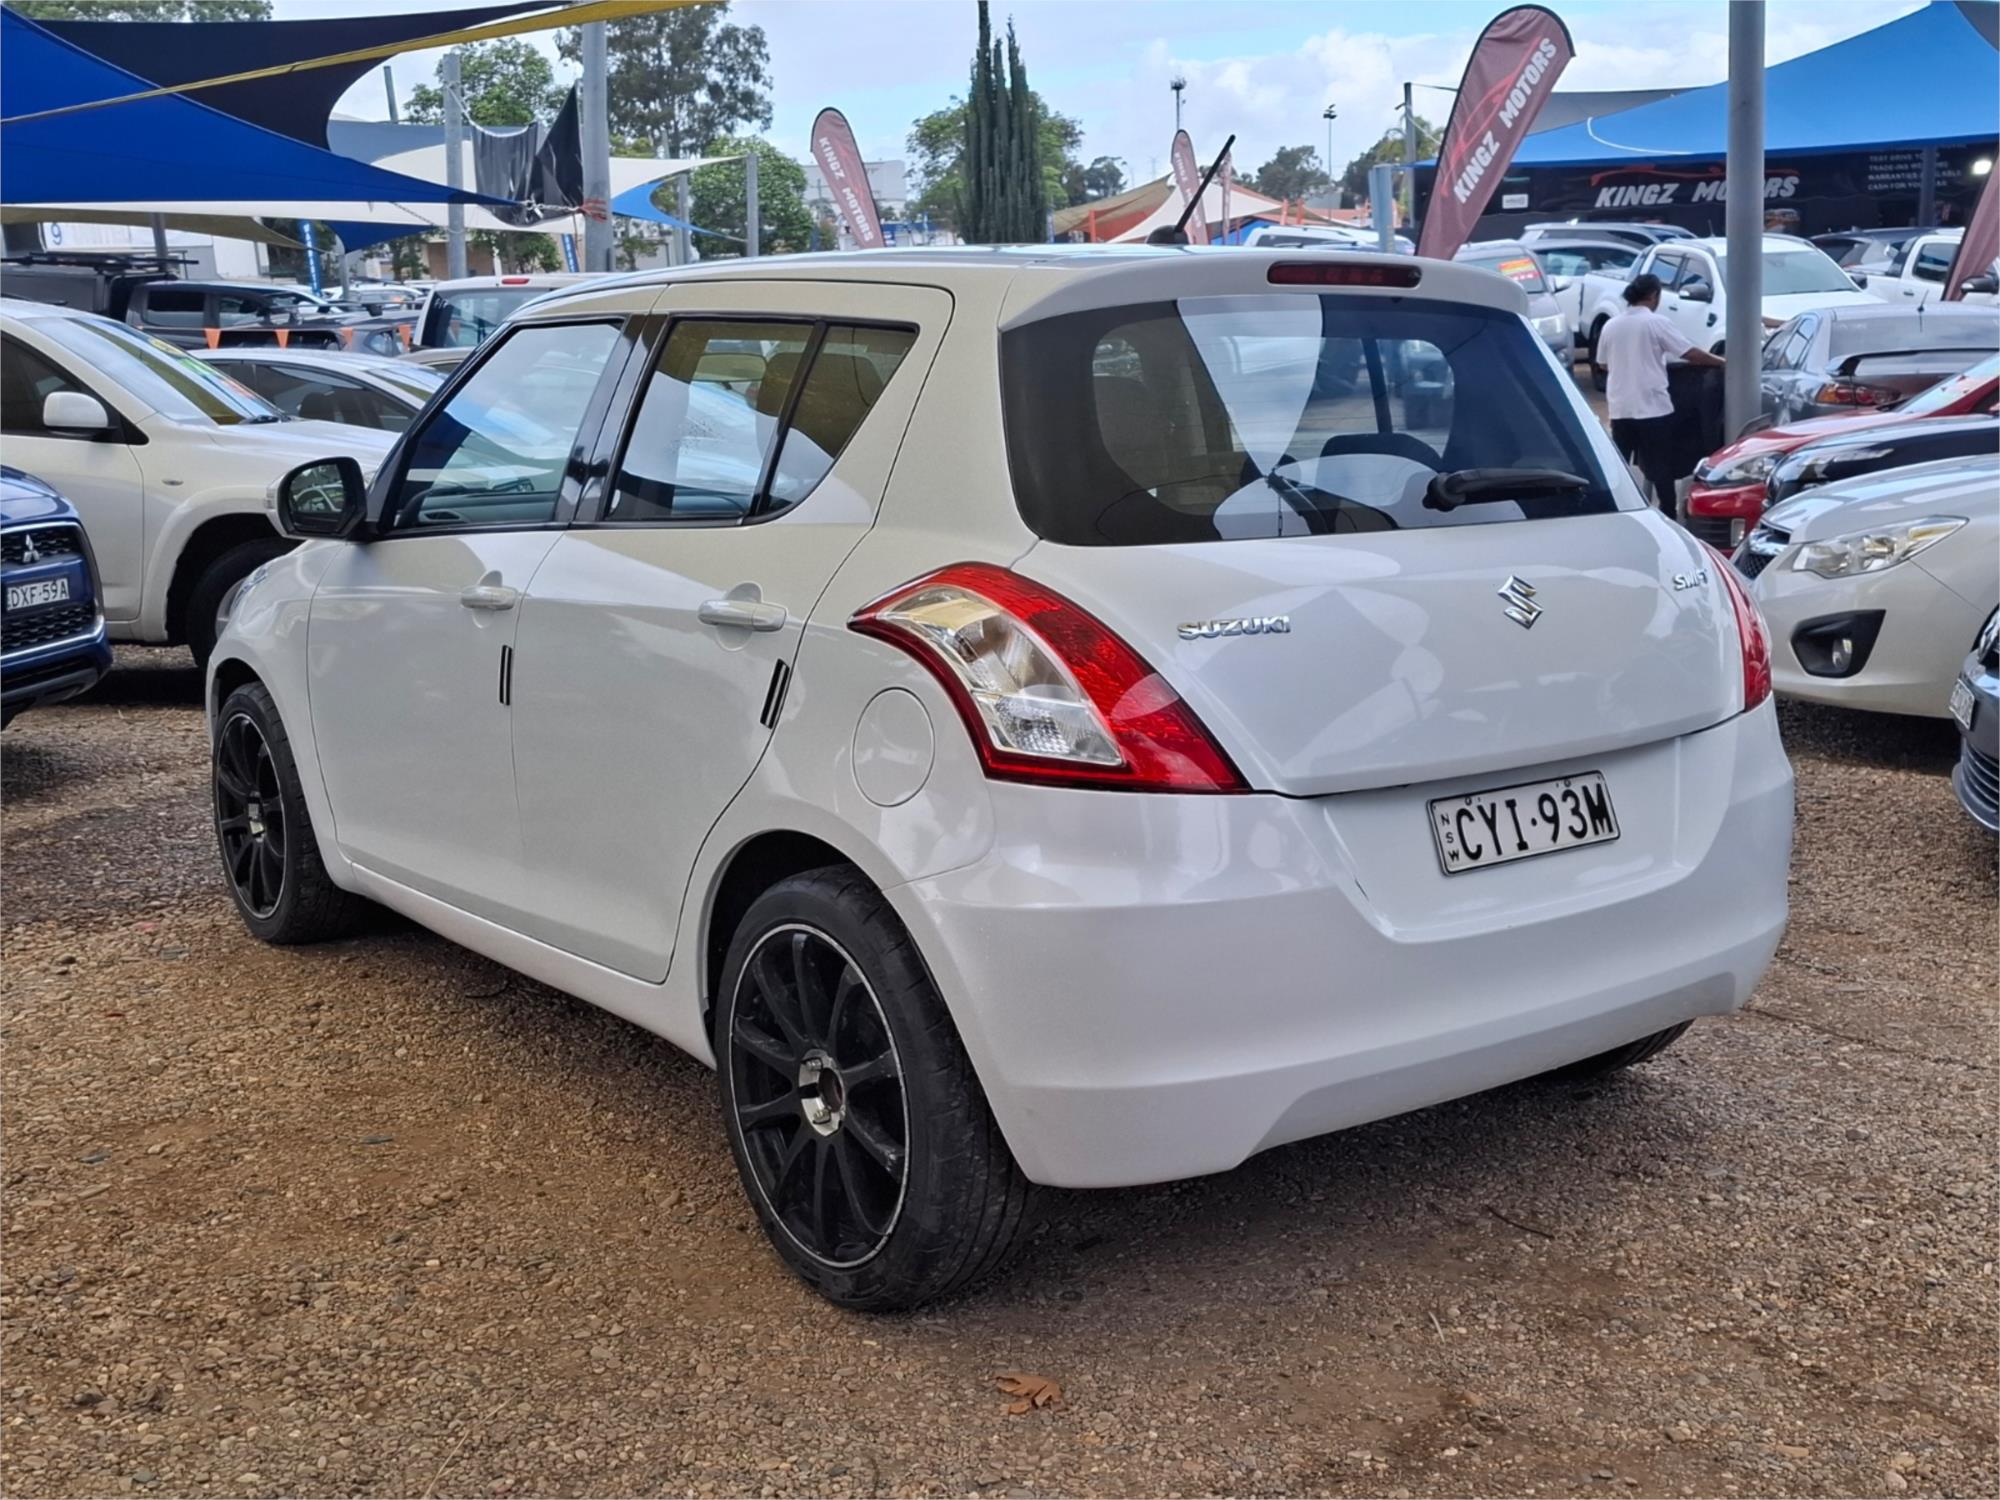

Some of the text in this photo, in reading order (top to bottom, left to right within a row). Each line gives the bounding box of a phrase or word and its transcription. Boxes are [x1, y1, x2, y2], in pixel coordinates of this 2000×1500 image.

[1453, 37, 1557, 204] KINGZ MOTORS
[819, 137, 874, 241] KINGZ MOTORS
[1594, 182, 1680, 208] KINGZ
[1177, 615, 1291, 641] SUZUKI
